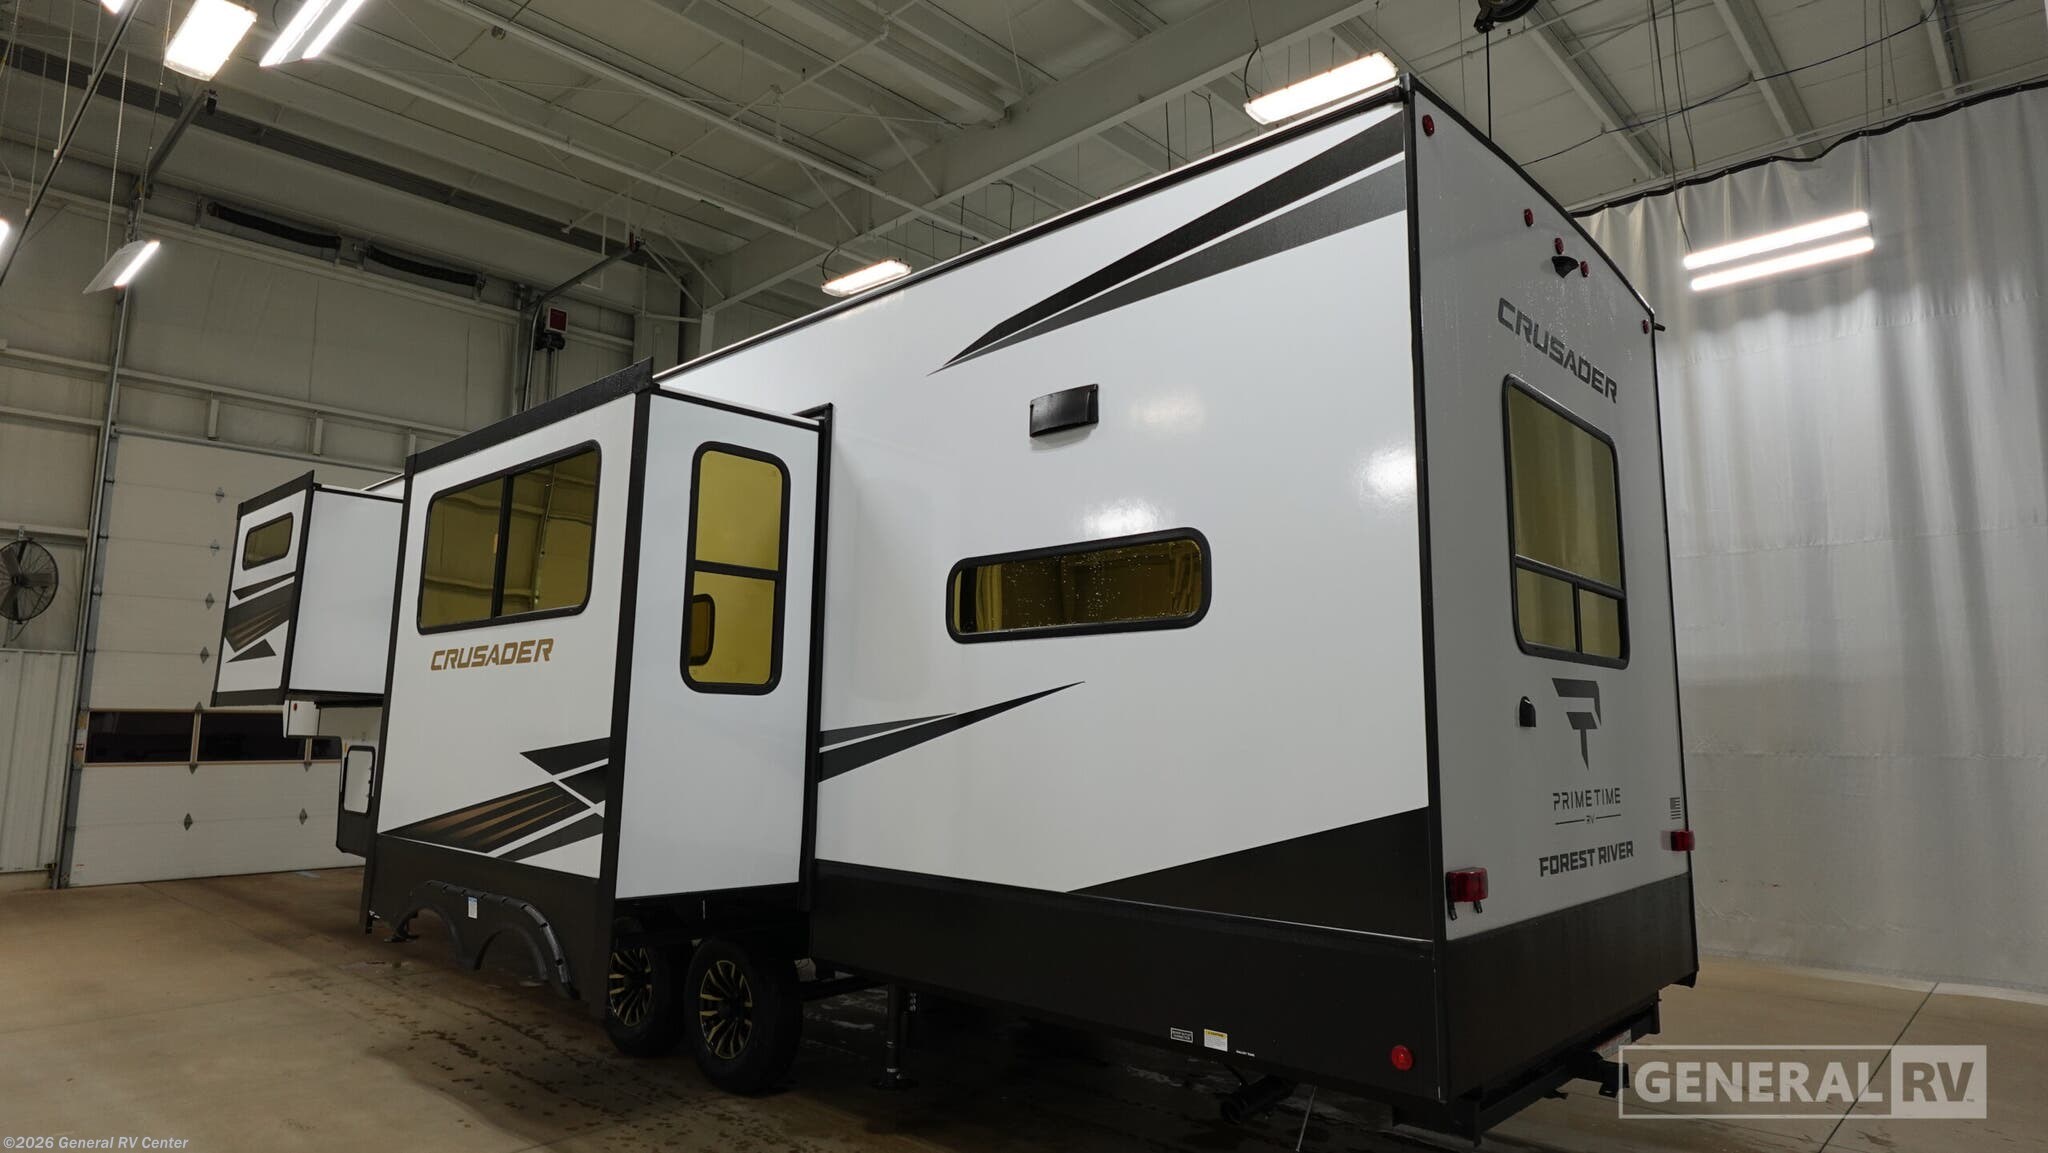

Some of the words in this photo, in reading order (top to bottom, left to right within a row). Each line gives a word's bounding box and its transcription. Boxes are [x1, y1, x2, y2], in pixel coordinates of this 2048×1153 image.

[1498, 297, 1617, 404] CRUSADER
[430, 638, 554, 671] CRUSADER
[1539, 848, 1596, 877] FOREST
[1598, 840, 1634, 865] RIVER
